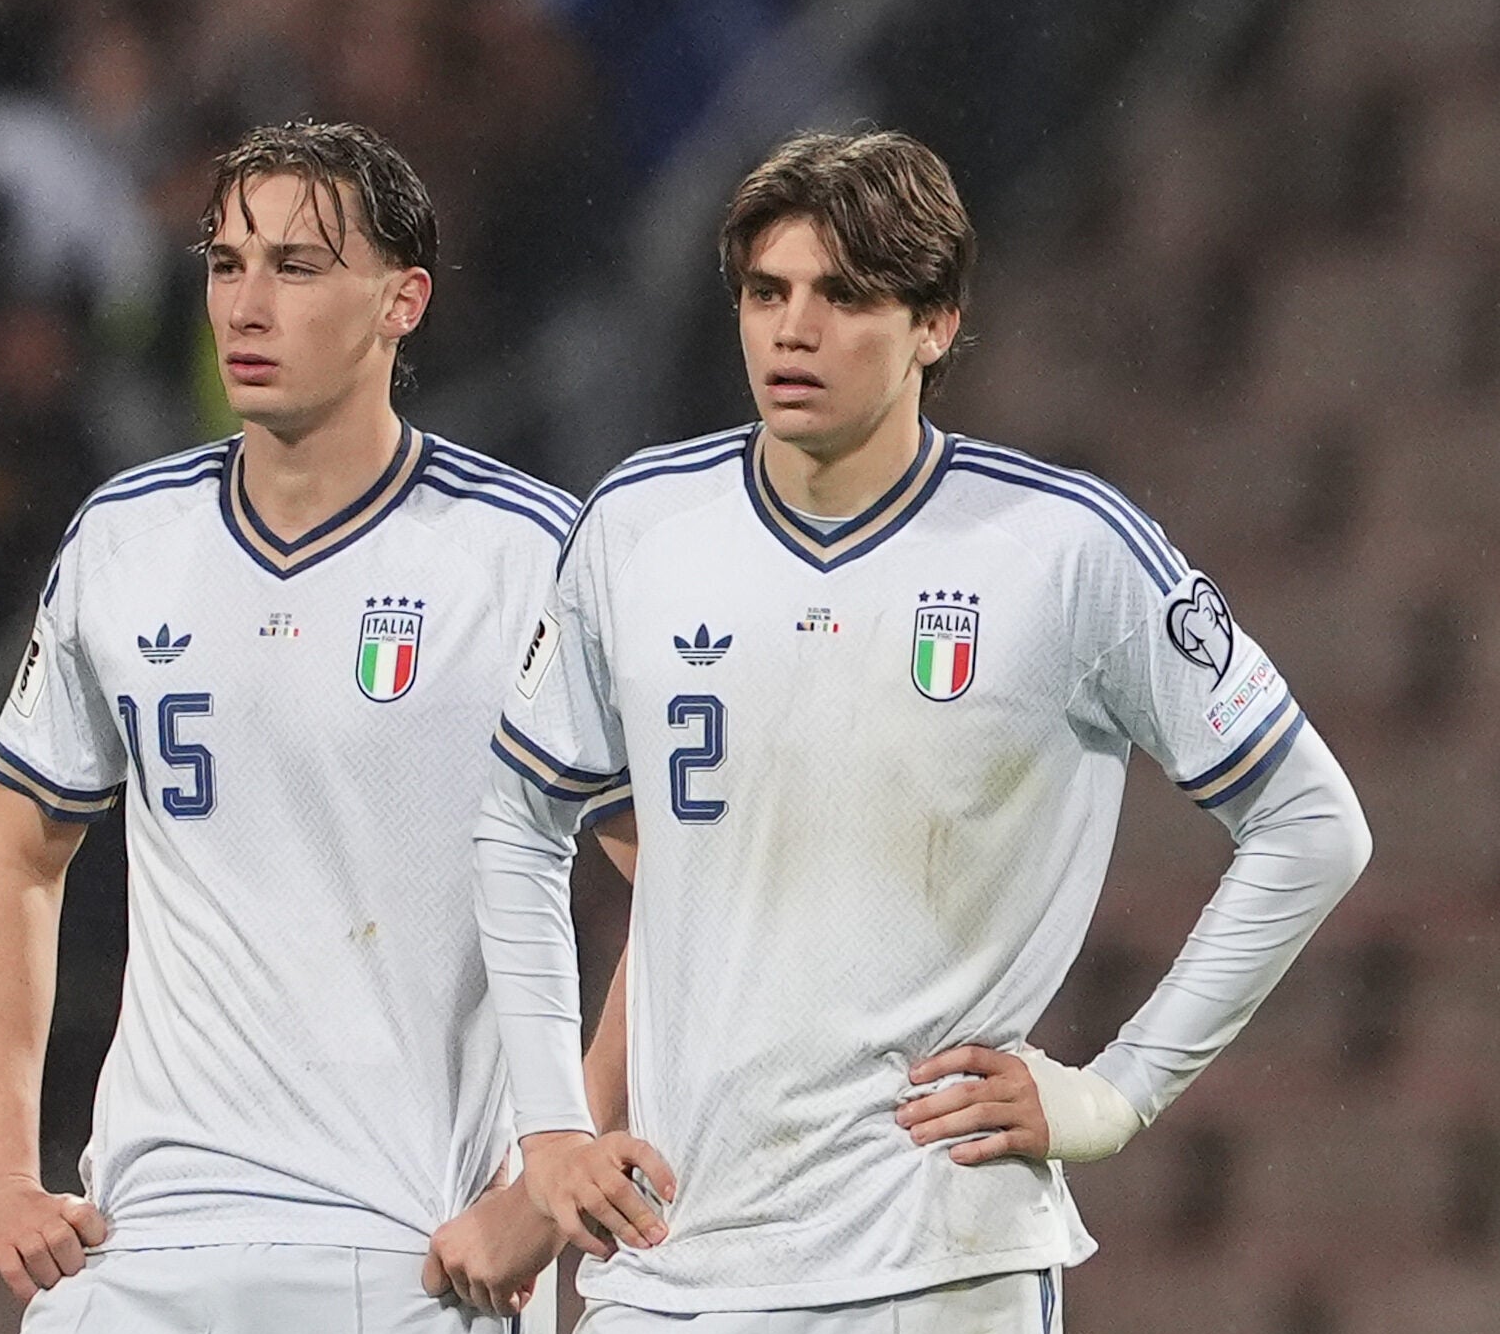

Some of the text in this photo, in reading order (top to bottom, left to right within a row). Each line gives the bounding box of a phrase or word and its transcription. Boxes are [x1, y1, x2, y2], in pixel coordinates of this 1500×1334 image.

[366, 618, 414, 635] ITALIA
[920, 614, 971, 633] ITALIA
[1212, 658, 1271, 733] FOUNDATION
[118, 693, 218, 821] 15
[667, 693, 728, 825] 2
